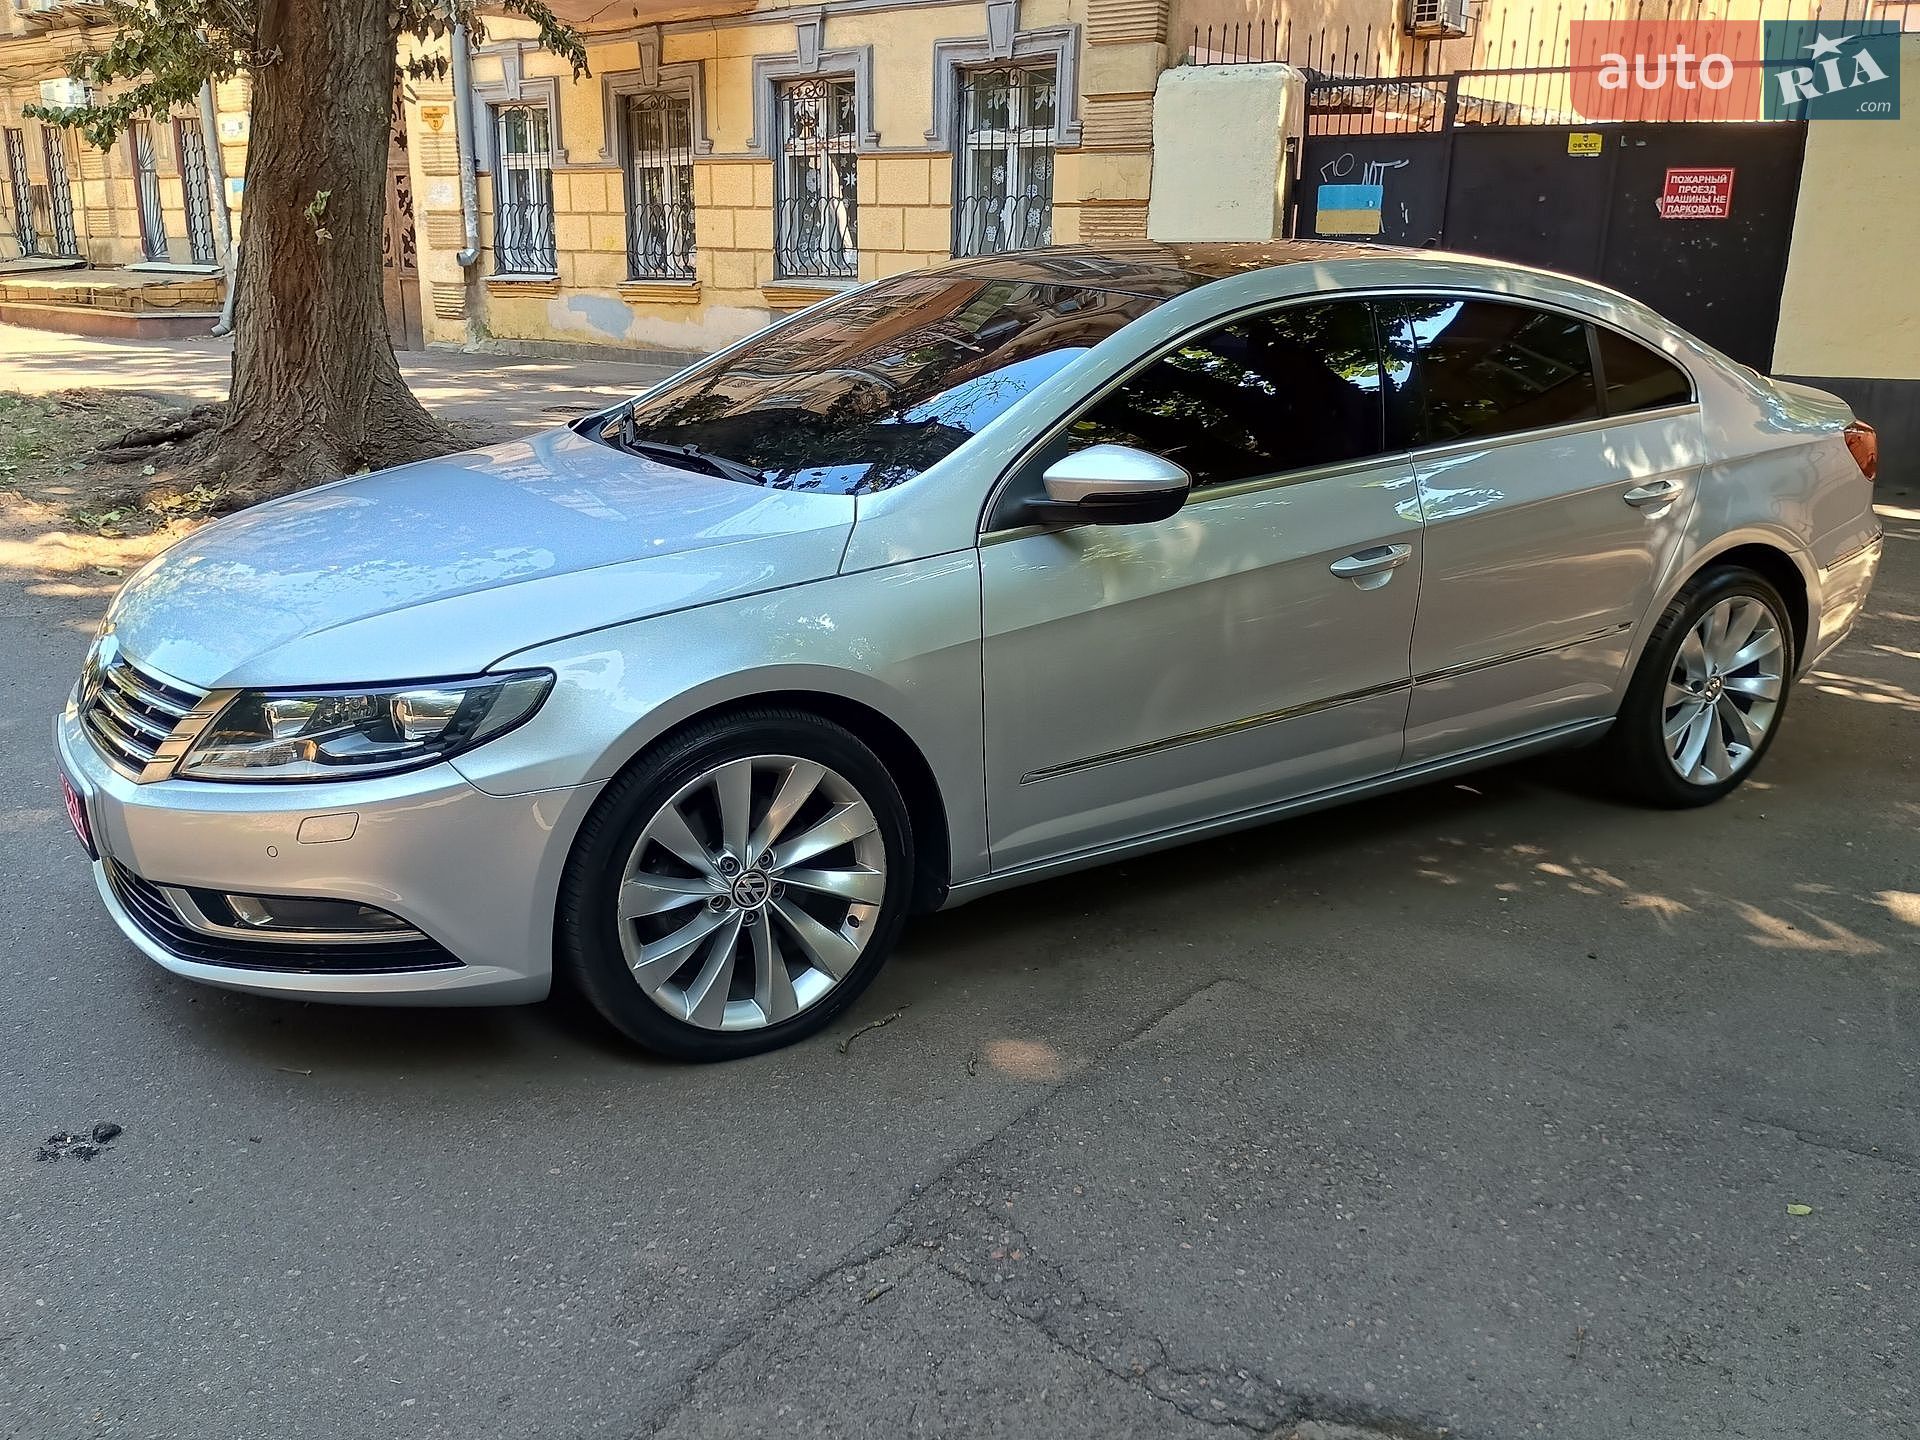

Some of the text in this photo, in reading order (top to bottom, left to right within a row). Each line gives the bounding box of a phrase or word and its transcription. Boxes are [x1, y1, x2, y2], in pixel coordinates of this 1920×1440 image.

[1670, 174, 1728, 184] ПОЖАРНЫЙ
[1678, 185, 1717, 194] ПРОЕЗД
[1666, 195, 1727, 204] МАШИНЫ НЕ
[1666, 205, 1723, 214] ПАРКОВАТЬ
